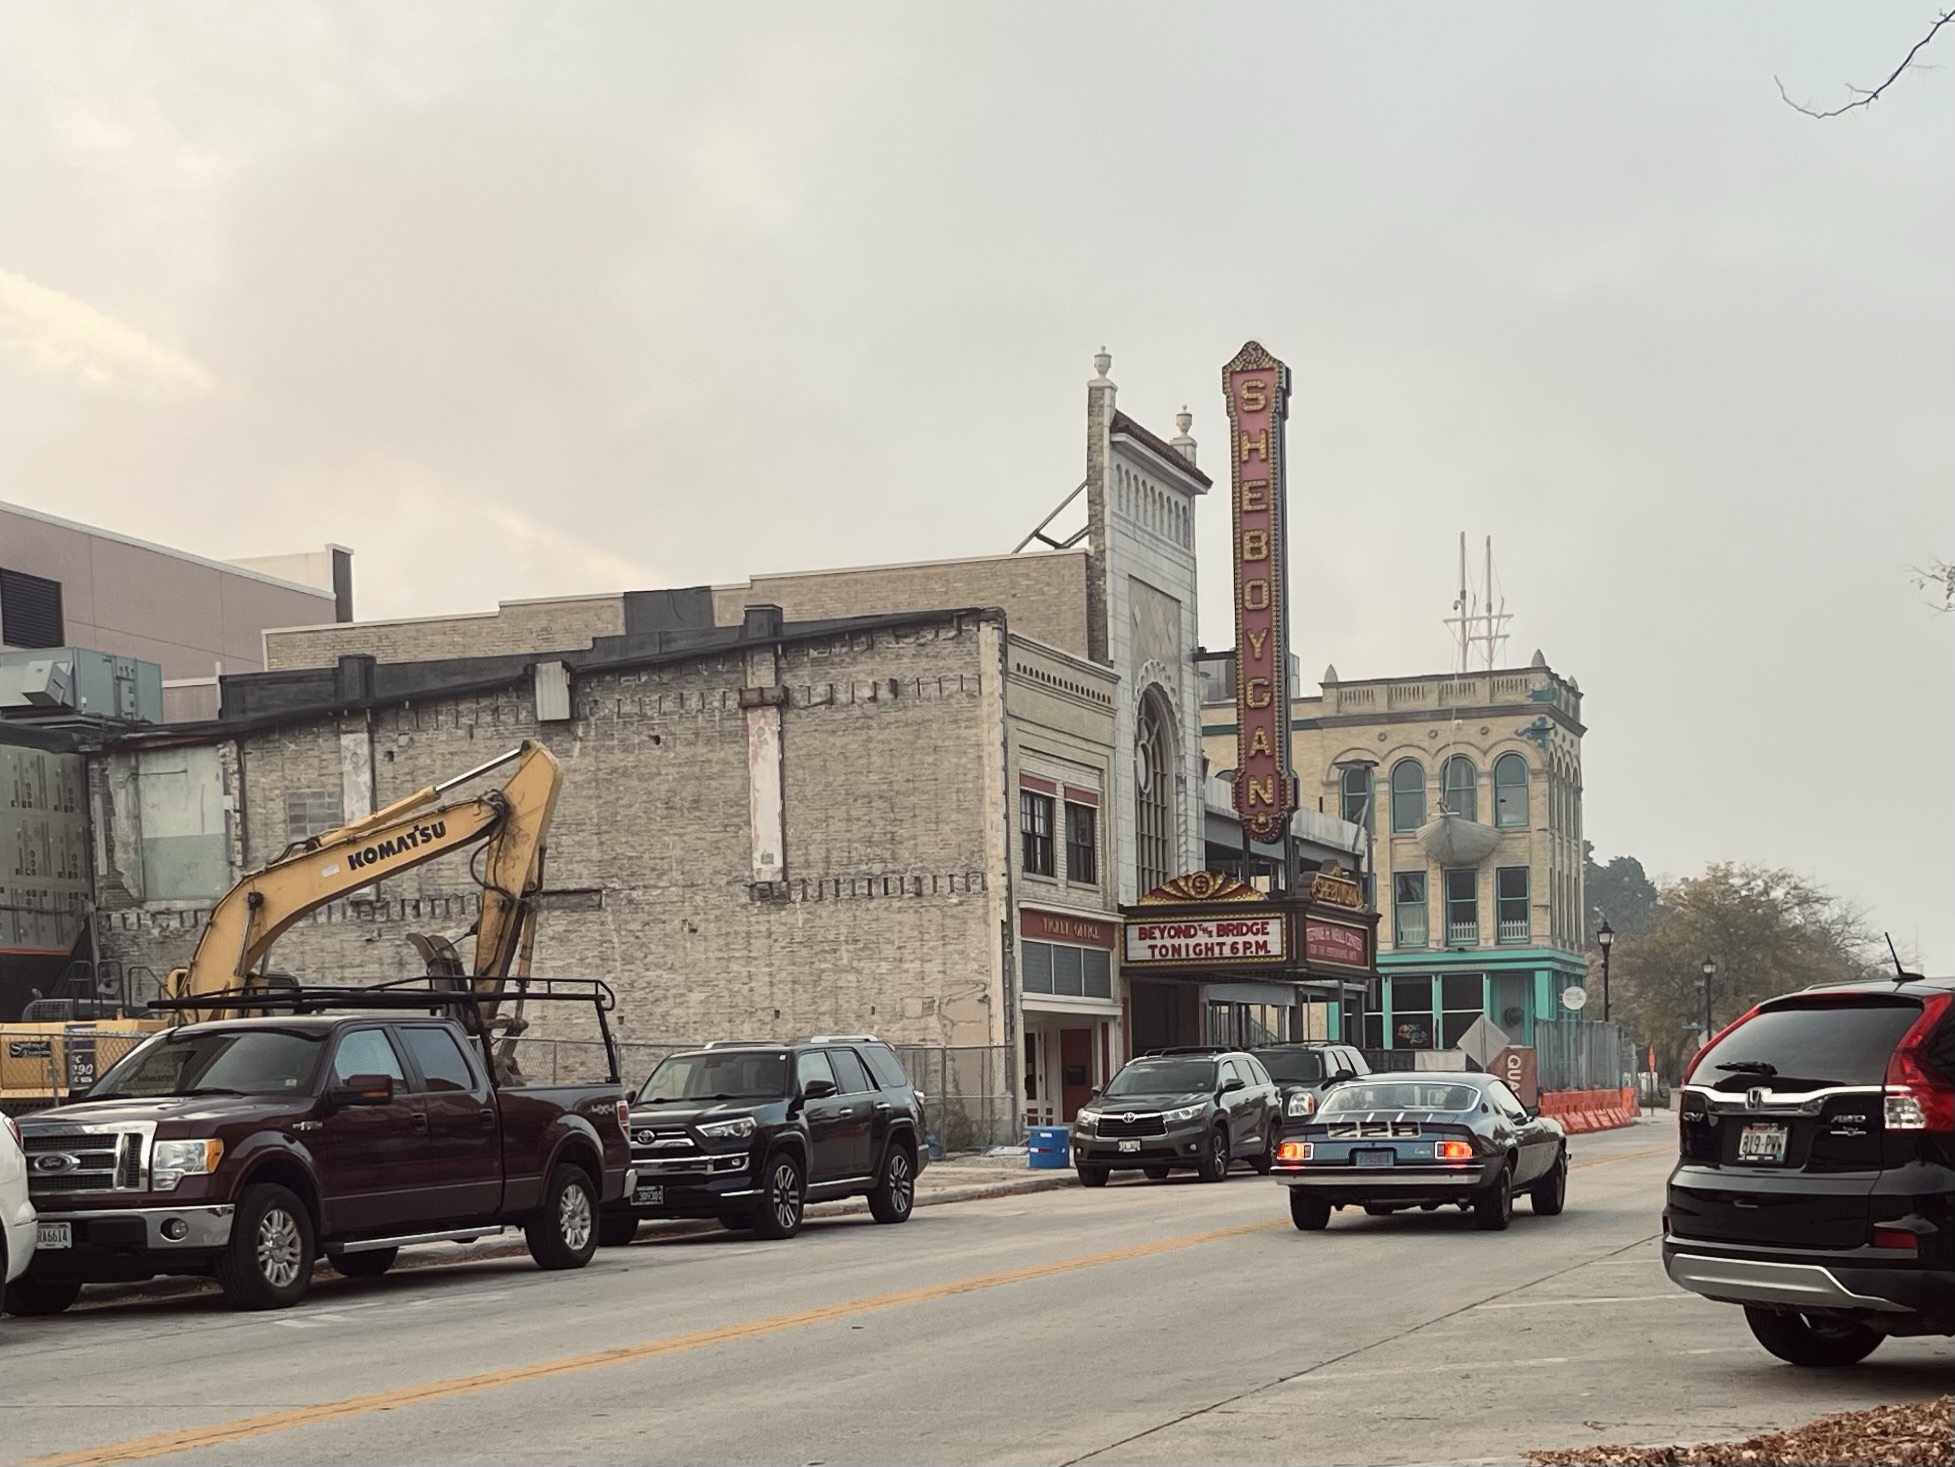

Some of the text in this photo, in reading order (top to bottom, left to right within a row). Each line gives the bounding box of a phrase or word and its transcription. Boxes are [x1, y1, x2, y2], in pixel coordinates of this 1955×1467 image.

[1239, 379, 1275, 806] SHEBOYGAN
[347, 821, 447, 871] KOMATSU
[1138, 924, 1198, 941] BEYOND
[1216, 921, 1270, 938] BRIDGE
[1147, 940, 1271, 959] TONIGHT 6 P.M.
[1506, 1054, 1522, 1099] QUA
[43, 1158, 62, 1168] Ford
